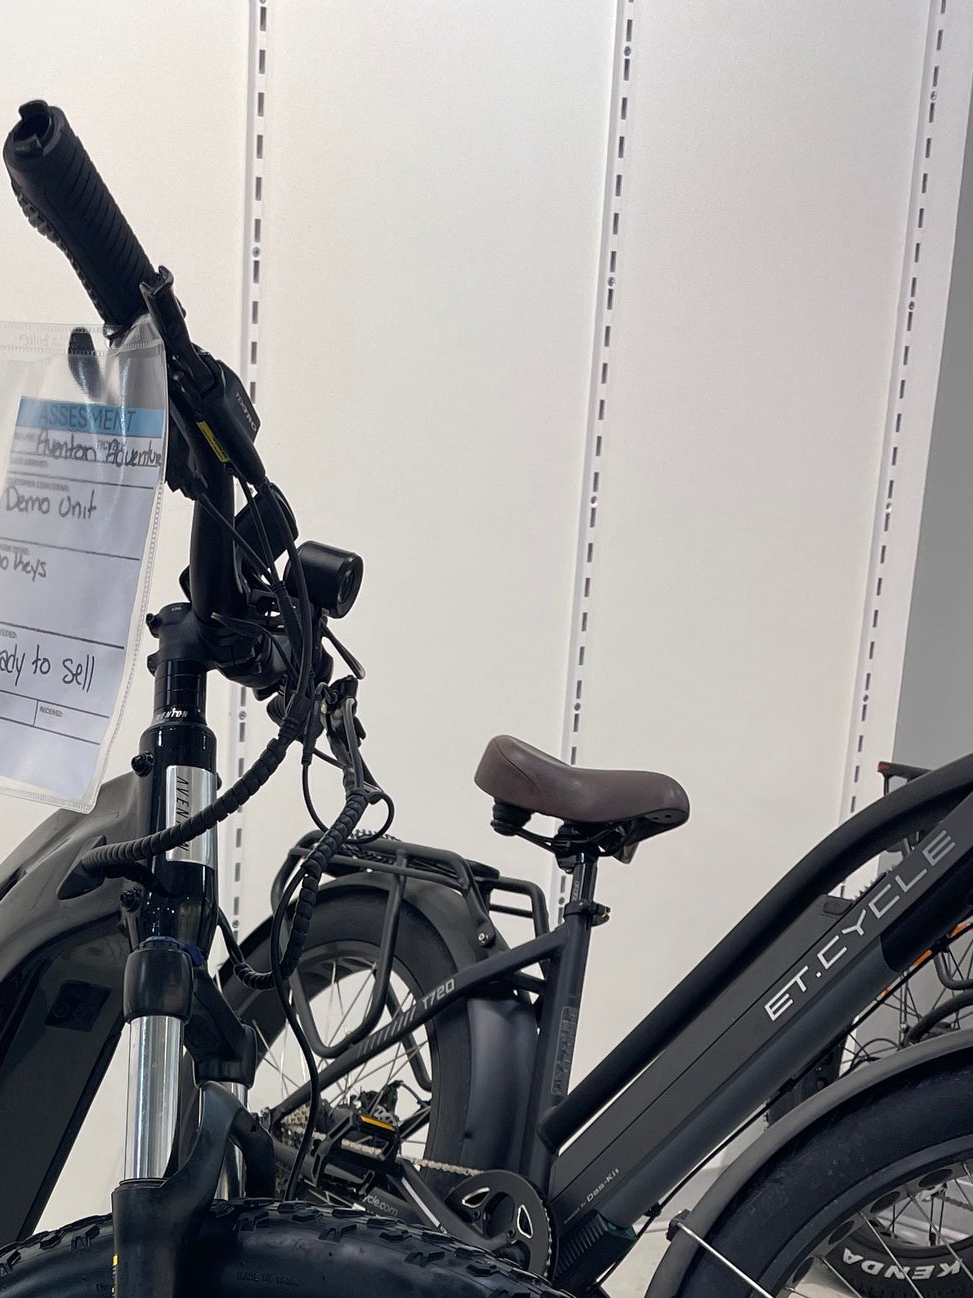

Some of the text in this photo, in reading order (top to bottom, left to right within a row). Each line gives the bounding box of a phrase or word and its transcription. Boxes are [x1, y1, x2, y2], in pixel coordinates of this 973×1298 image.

[6, 485, 97, 519] Demo Unit
[31, 644, 51, 675] to
[176, 775, 190, 852] AVENN
[764, 830, 956, 1022] ET.CYCLE
[842, 1247, 963, 1280] KENDA
